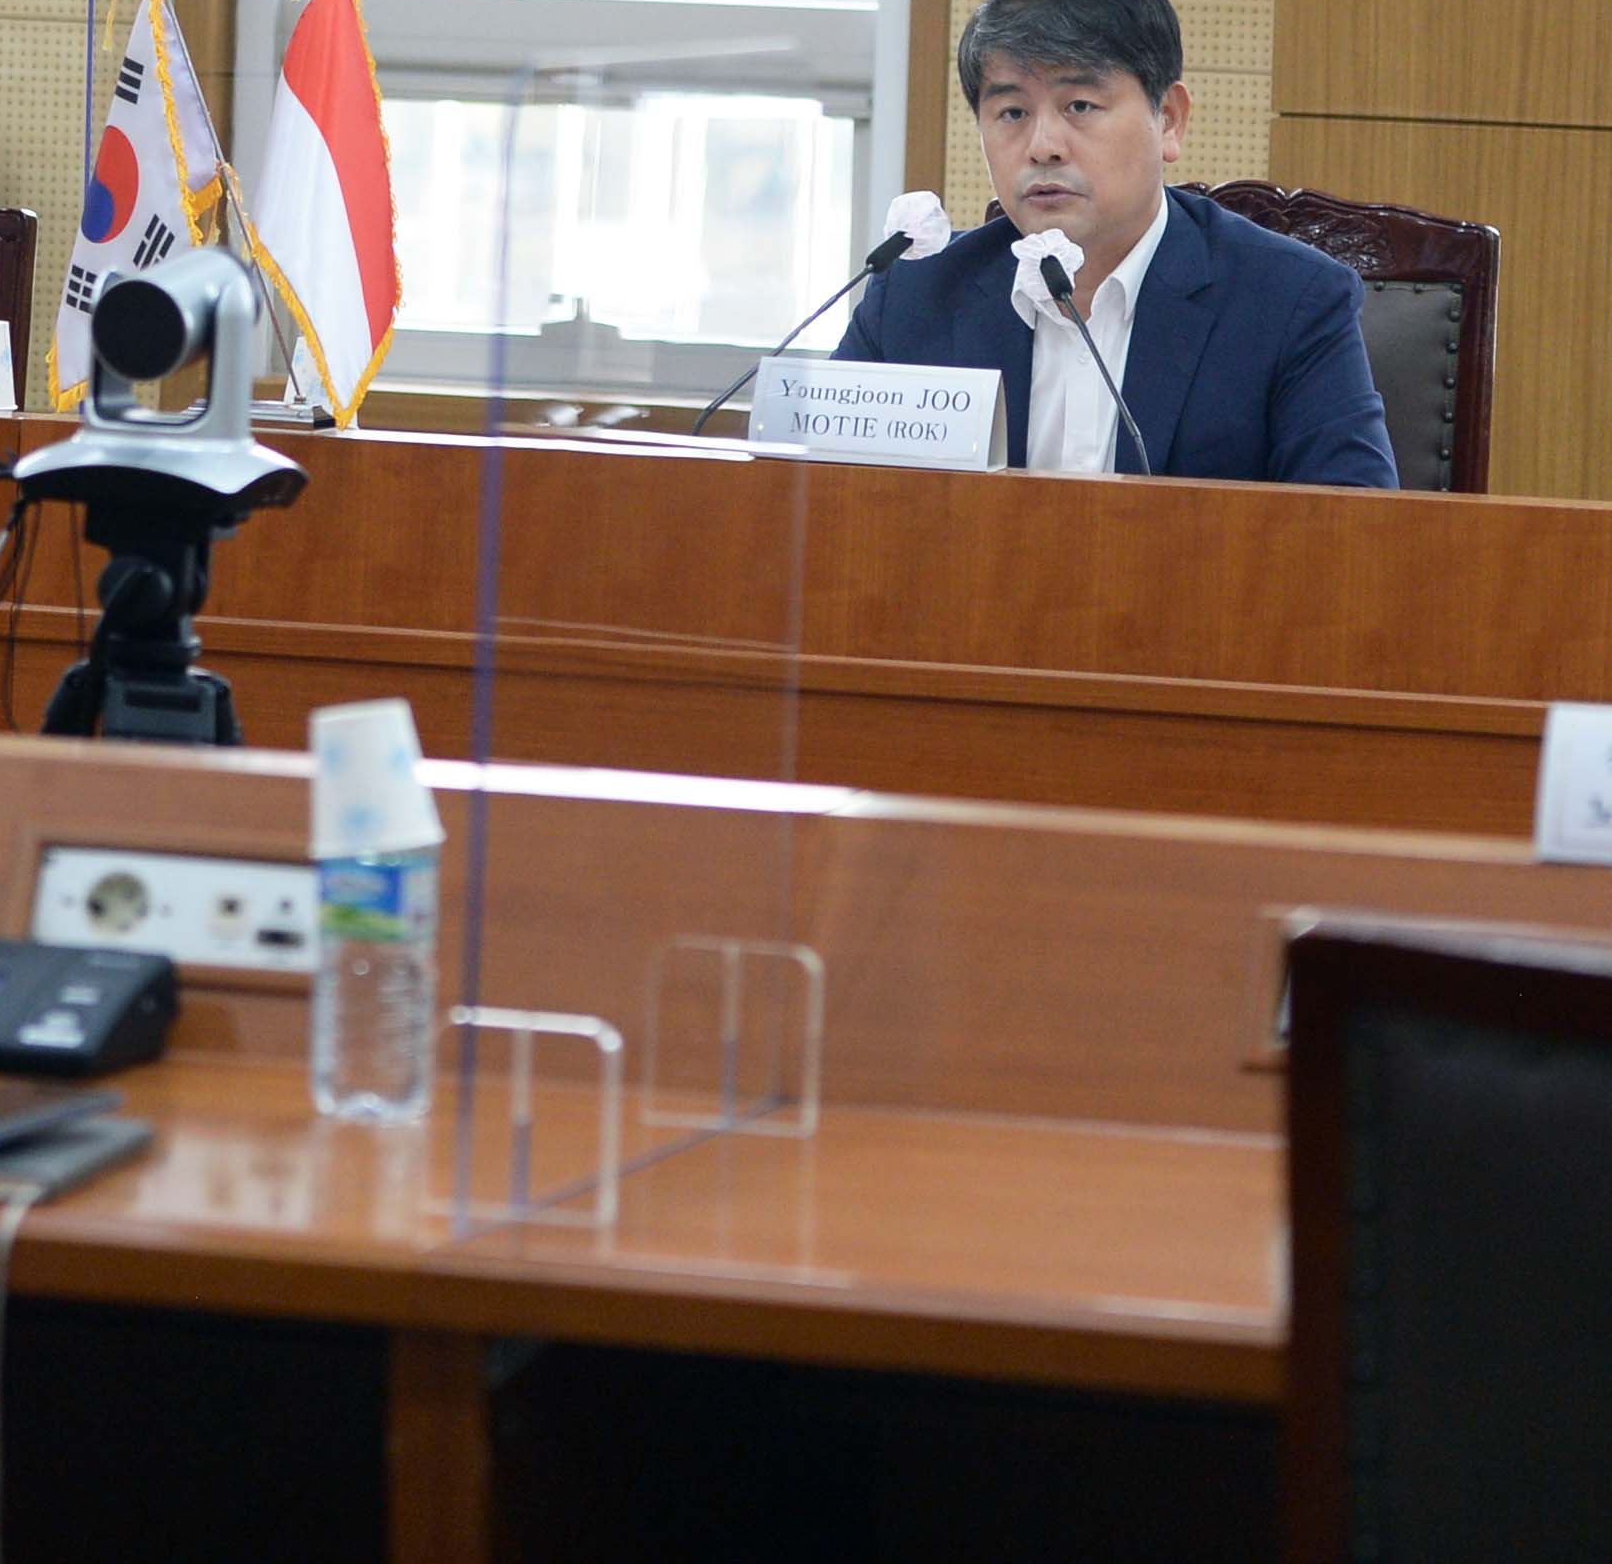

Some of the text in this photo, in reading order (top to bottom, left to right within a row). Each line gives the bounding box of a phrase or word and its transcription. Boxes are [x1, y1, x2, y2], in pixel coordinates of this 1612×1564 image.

[779, 378, 972, 413] Youngjoon JOO
[789, 412, 948, 442] MOTIE (ROK)
